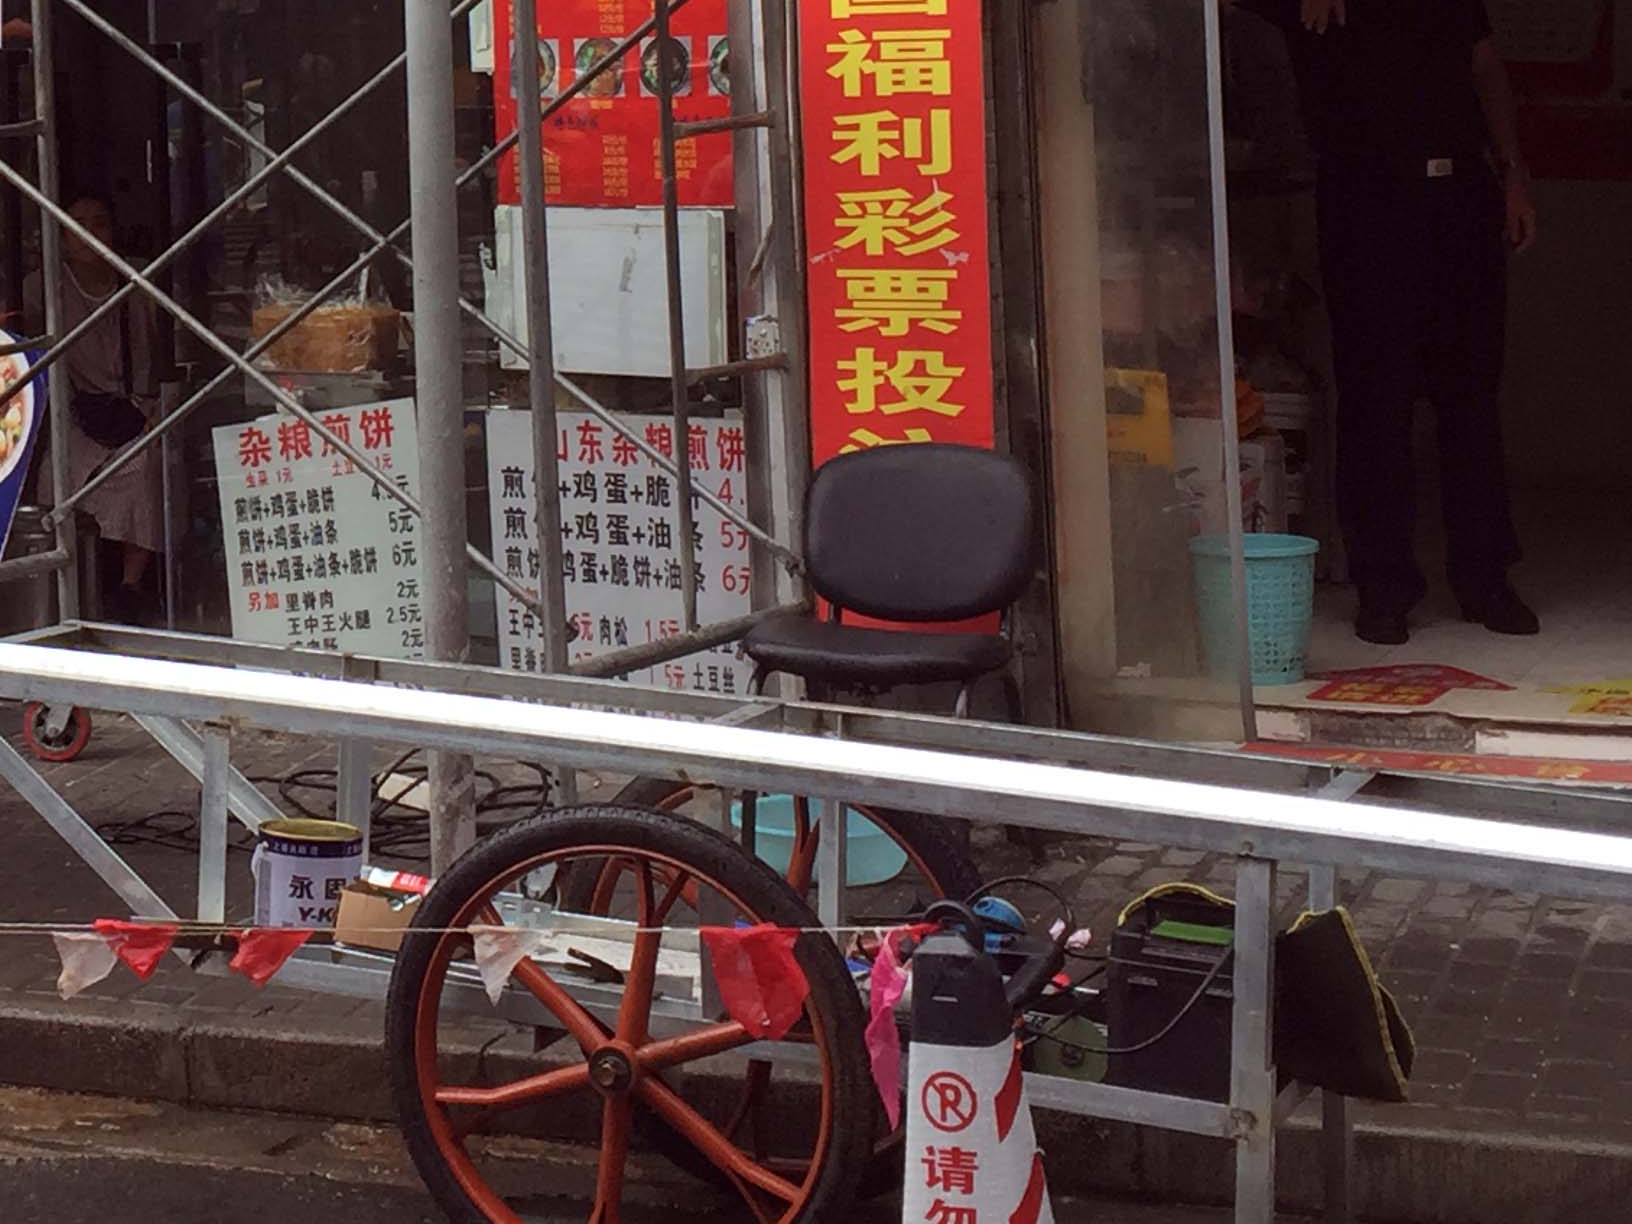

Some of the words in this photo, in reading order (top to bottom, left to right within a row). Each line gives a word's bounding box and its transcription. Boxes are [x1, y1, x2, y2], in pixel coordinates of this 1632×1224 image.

[239, 407, 395, 468] 杂粮煎饼
[234, 485, 336, 523] 煎饼+鸡蛋+脆饼
[501, 465, 701, 510] 煎+鸡蛋+脆
[237, 519, 339, 555] 煎饼+鸡蛋+油条
[388, 508, 414, 534] 5元
[503, 507, 704, 551] 煎+鸡蛋+油条
[392, 540, 418, 568] 6元
[247, 591, 279, 613] 另加
[285, 589, 334, 613] 里脊肉
[396, 578, 420, 599] 2元
[287, 609, 371, 636] 王中王火腿
[401, 627, 424, 648] 2元
[599, 614, 629, 646] 肉松
